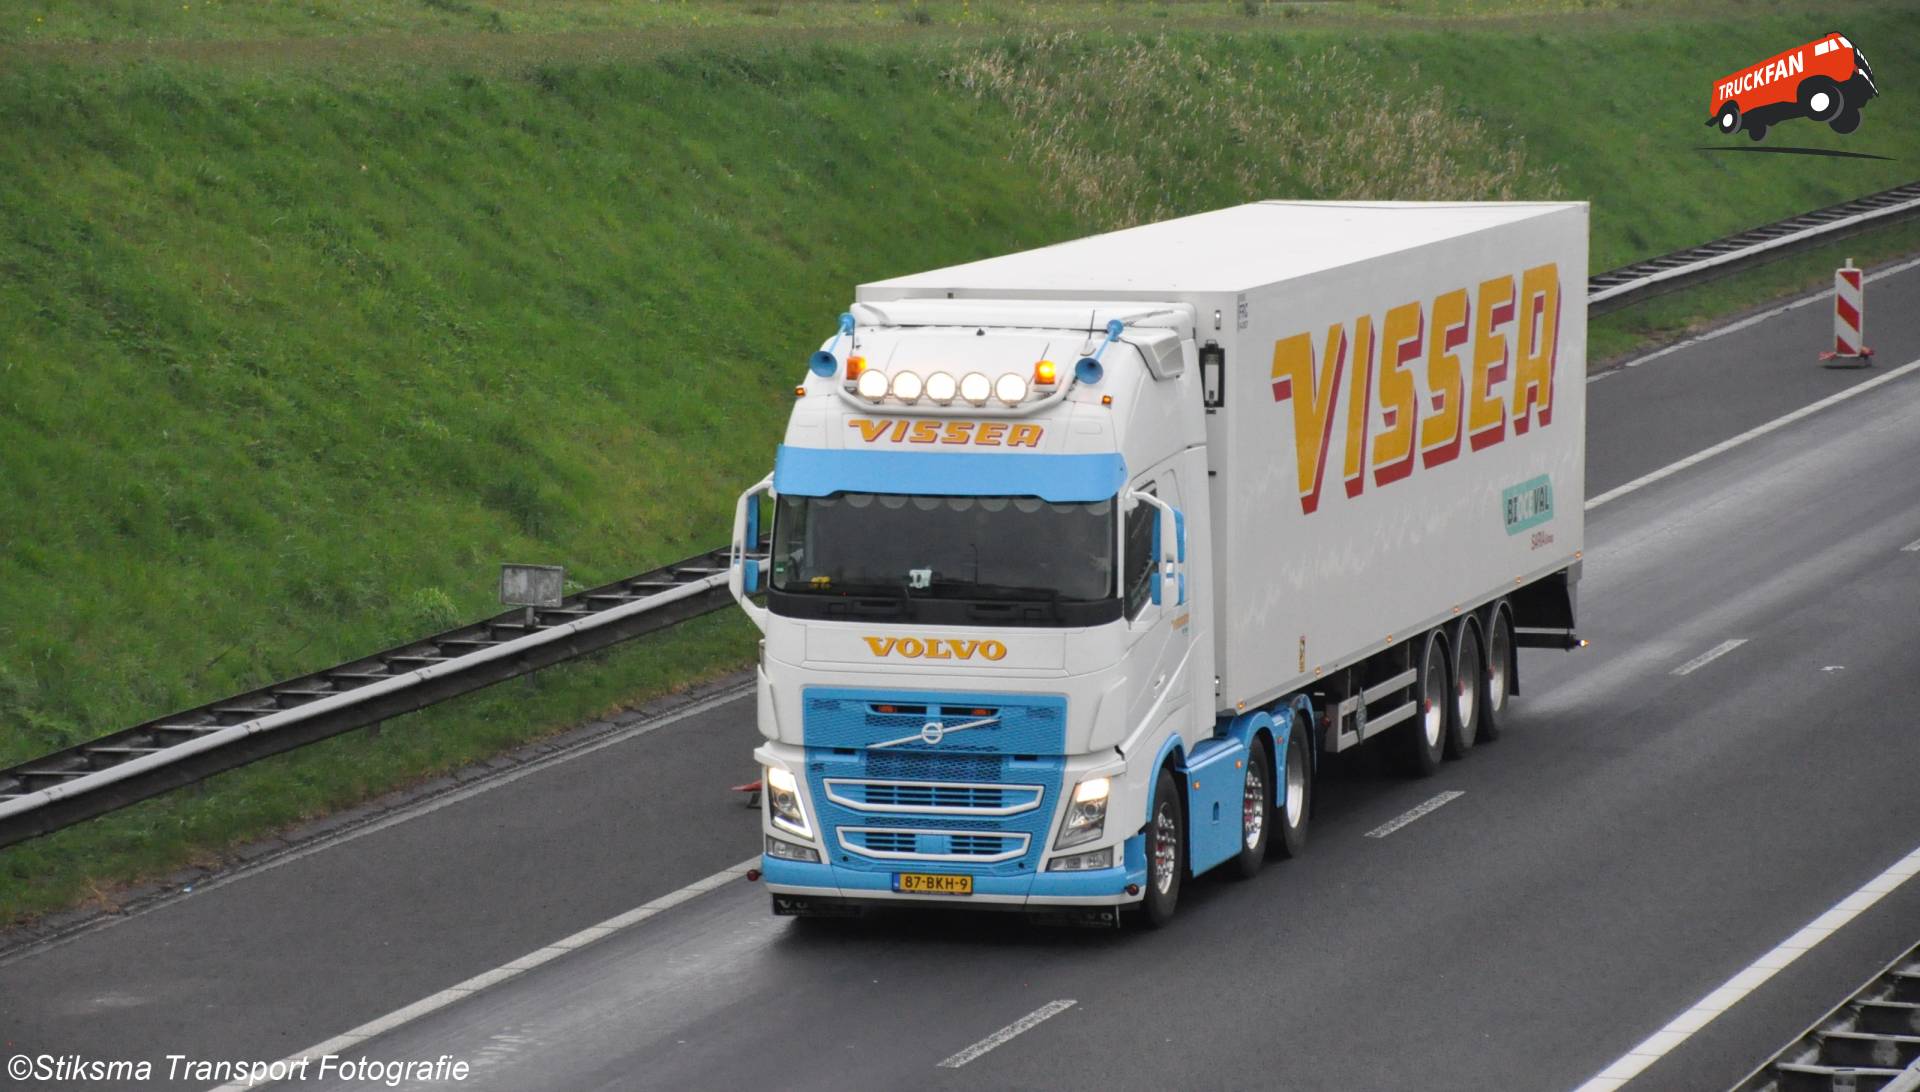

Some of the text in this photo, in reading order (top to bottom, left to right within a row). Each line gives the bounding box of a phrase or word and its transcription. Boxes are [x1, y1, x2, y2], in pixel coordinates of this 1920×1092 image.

[1271, 262, 1561, 515] VISSER
[848, 419, 1044, 447] VISSER
[863, 636, 1007, 661] VOLVO
[904, 876, 968, 890] 87-BKH-9
